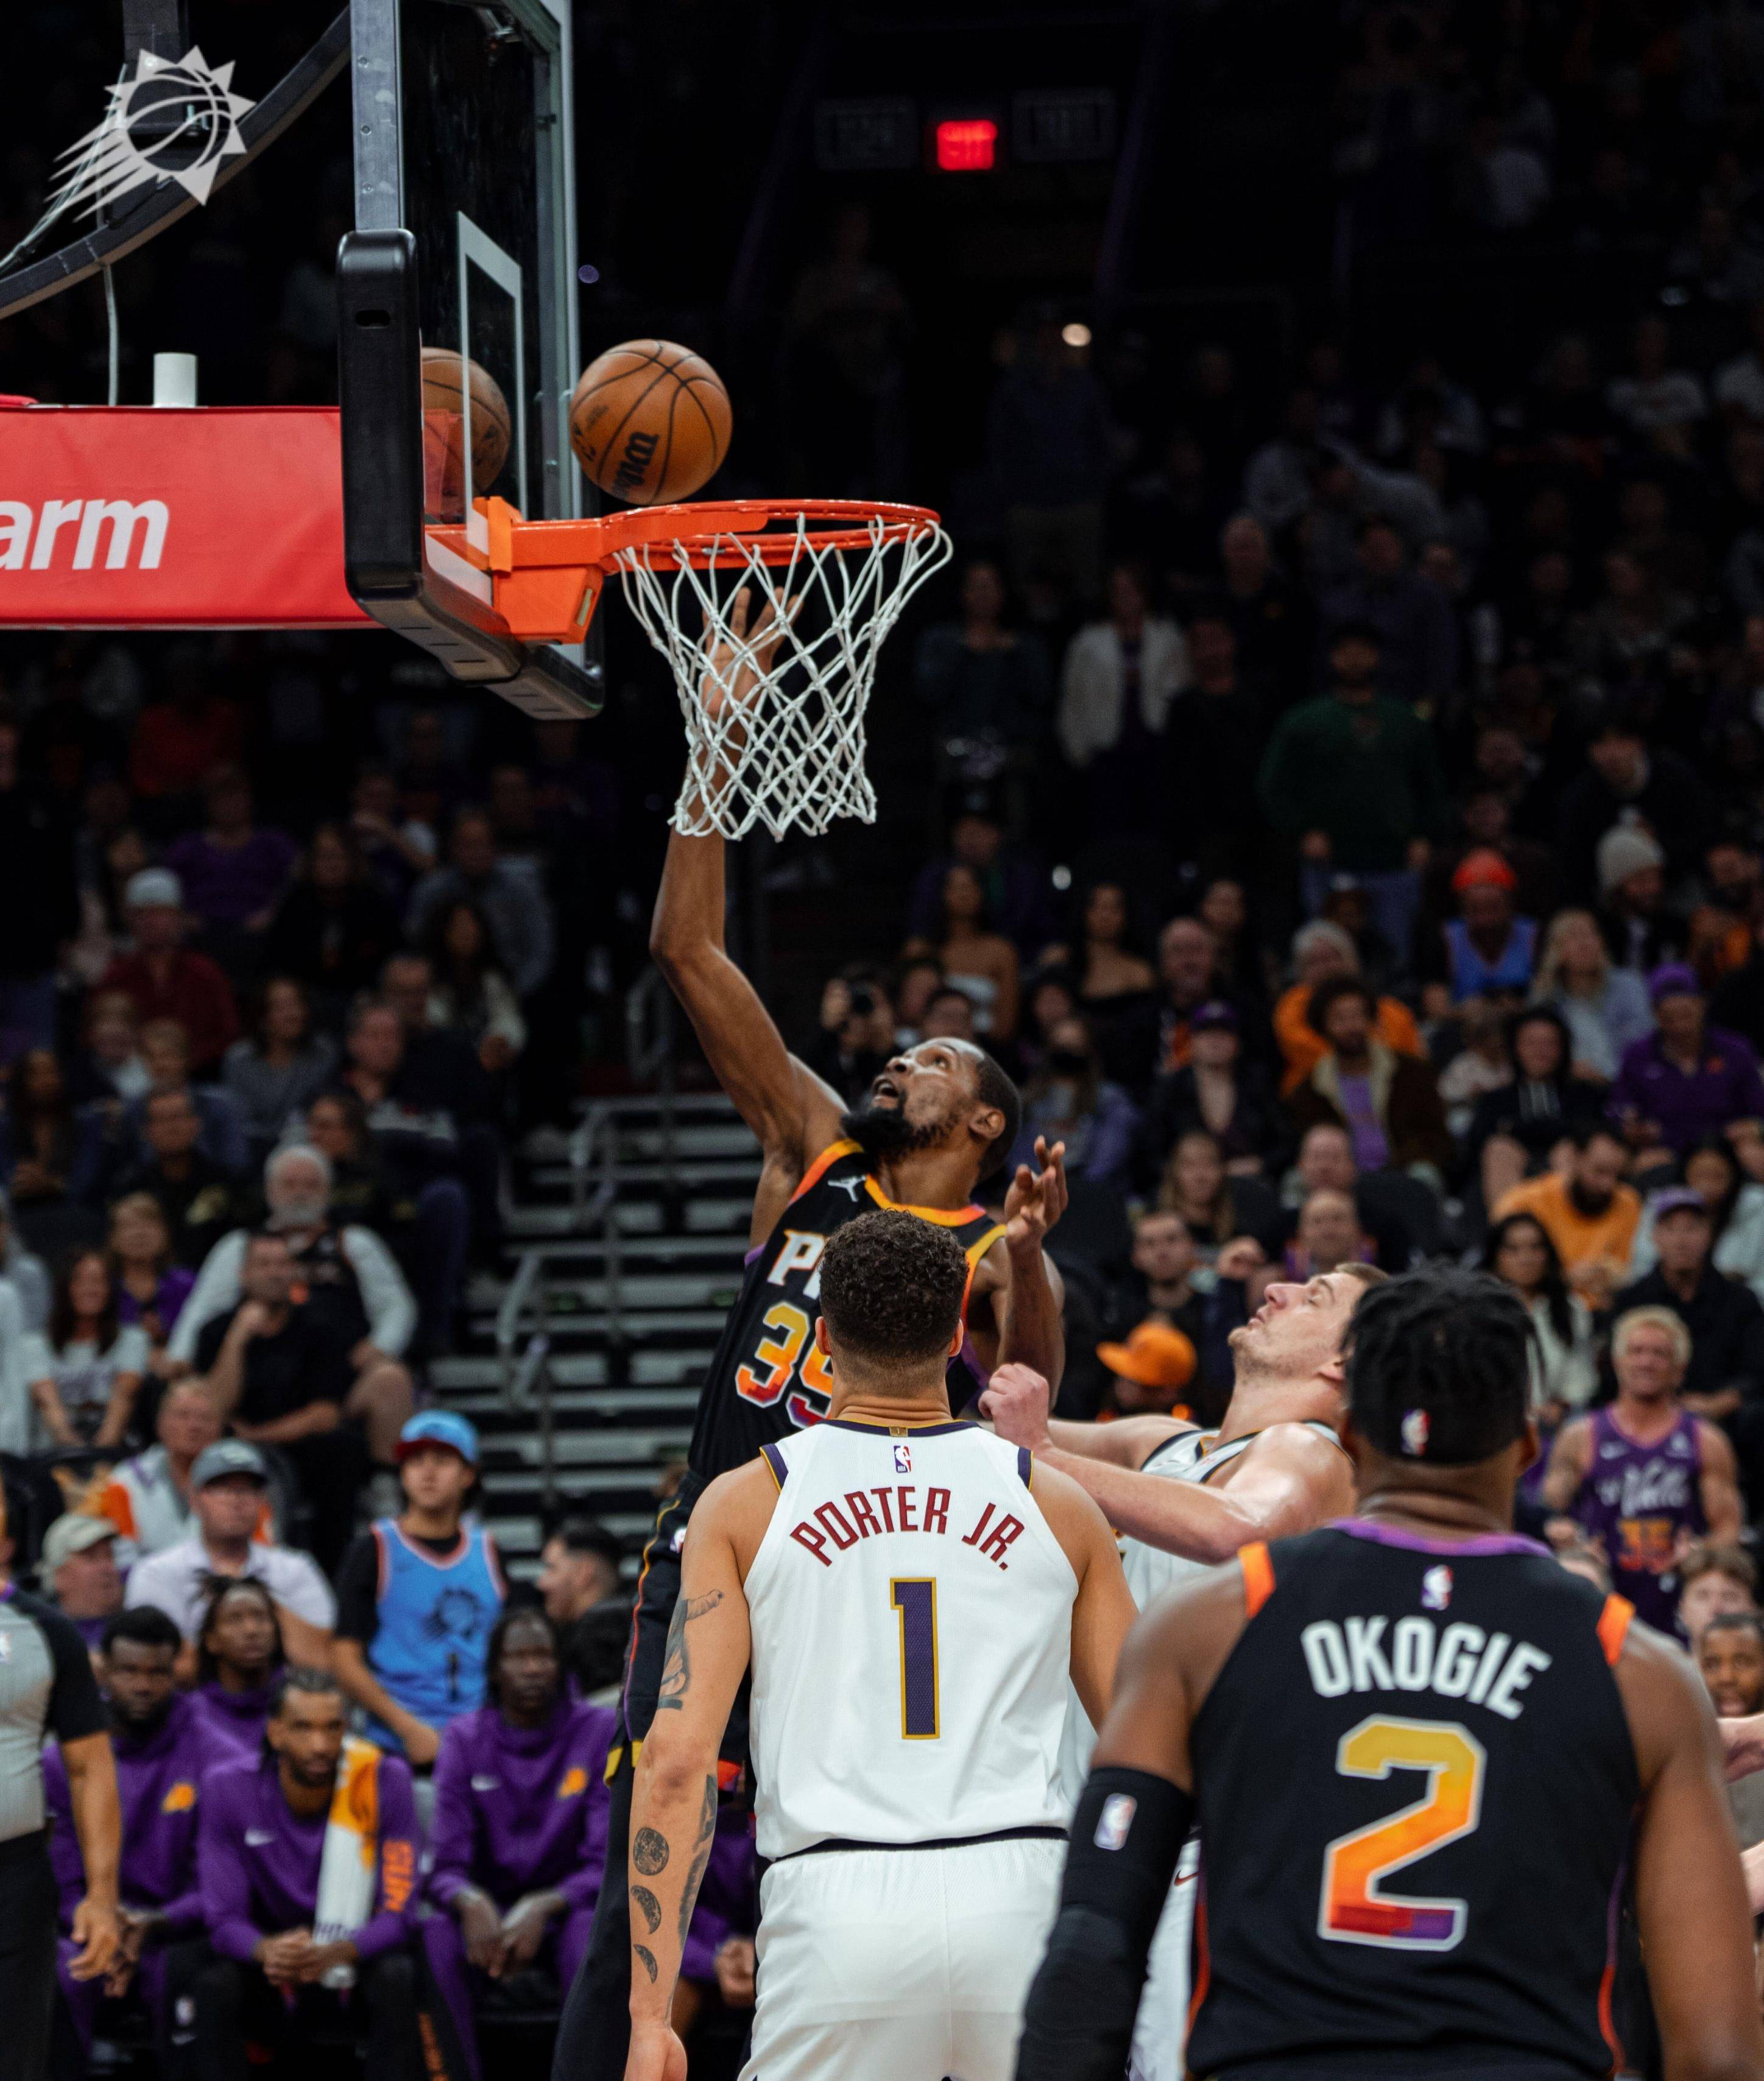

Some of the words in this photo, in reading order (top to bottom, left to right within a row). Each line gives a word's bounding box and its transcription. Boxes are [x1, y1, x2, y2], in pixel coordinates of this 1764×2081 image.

[0, 499, 169, 570] arm
[767, 1228, 827, 1301] P
[789, 1486, 951, 1567] PORTER
[962, 1502, 1025, 1571] JR.
[889, 1577, 940, 1740] 1
[1300, 1614, 1554, 1720] OKOGIE
[1316, 1712, 1488, 1952] 2
